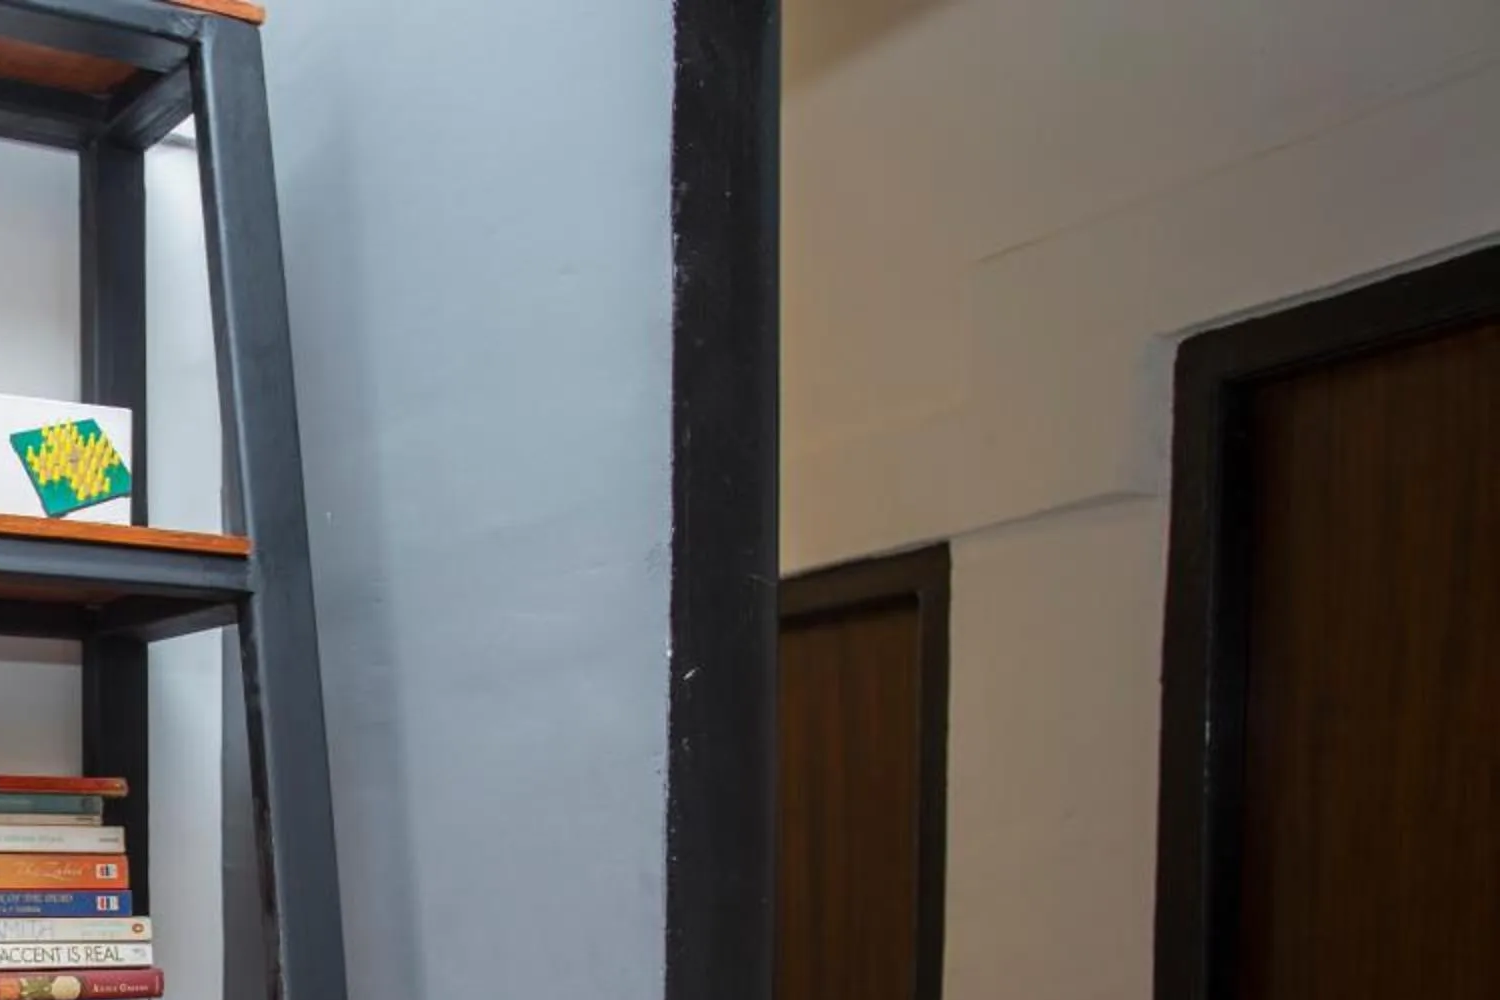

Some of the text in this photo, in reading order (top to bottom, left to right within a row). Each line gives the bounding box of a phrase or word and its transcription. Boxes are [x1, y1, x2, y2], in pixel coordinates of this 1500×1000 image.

[0, 946, 62, 963] ACCENT
[67, 945, 80, 963] IS
[84, 945, 124, 962] REAL
